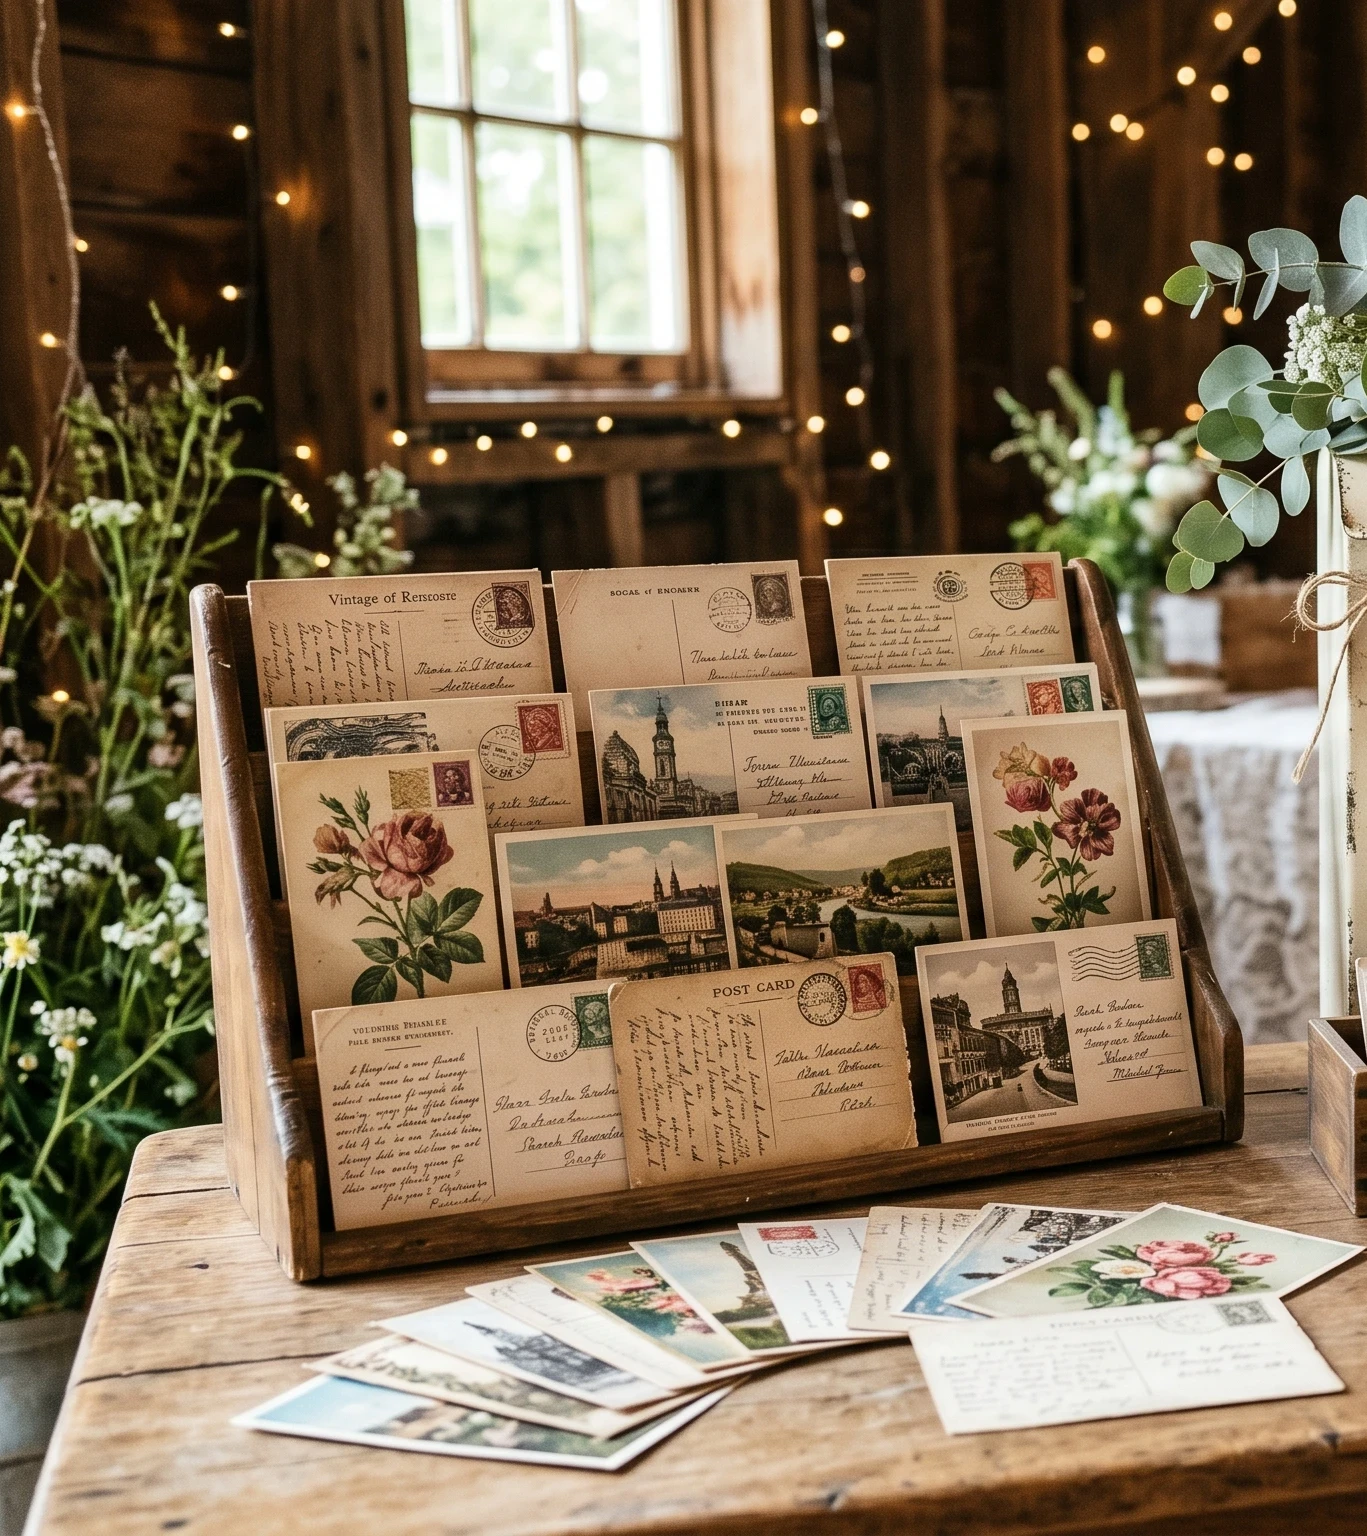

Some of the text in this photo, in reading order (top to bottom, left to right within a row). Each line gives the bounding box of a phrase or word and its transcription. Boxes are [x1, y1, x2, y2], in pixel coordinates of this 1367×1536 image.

[328, 592, 378, 607] Vintage
[383, 592, 396, 603] of
[712, 979, 796, 998] POST CARD
